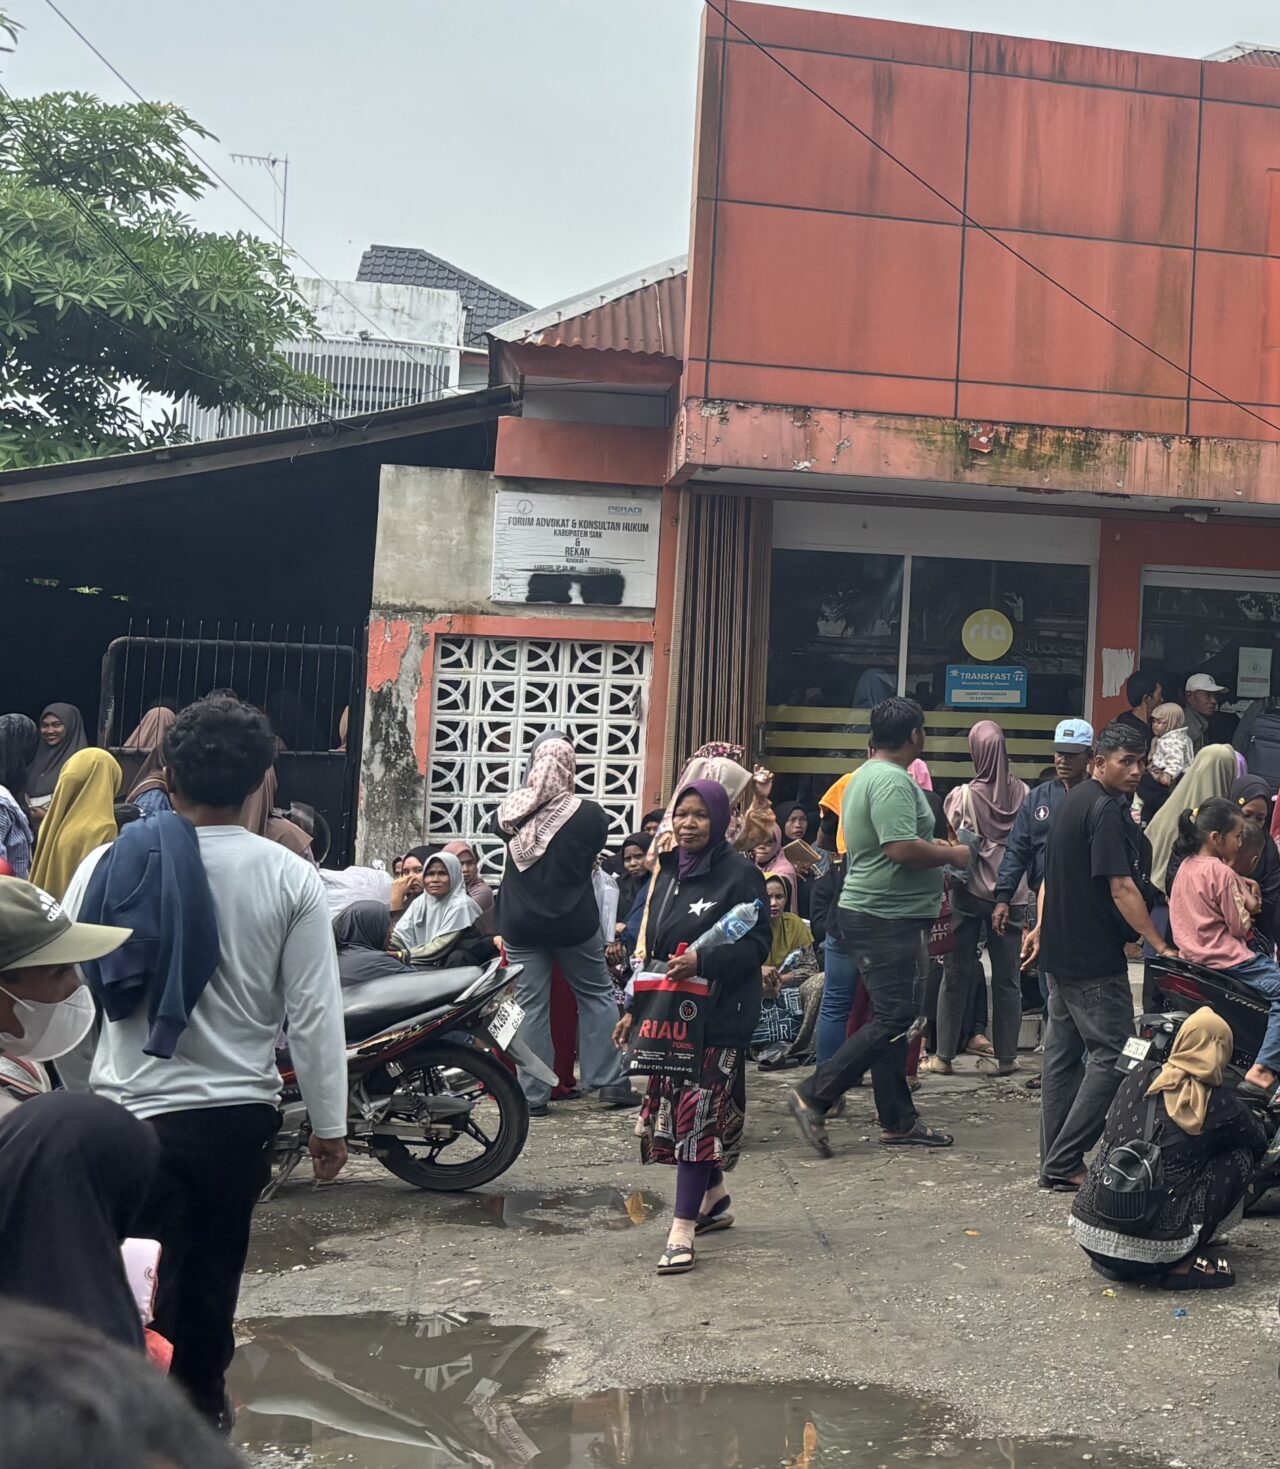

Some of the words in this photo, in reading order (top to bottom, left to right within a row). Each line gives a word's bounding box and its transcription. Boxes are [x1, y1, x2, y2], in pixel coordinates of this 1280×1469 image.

[508, 516, 534, 526] FORUM
[535, 518, 570, 528] ADVOKAT
[572, 519, 577, 528] &
[578, 519, 621, 531] KONSULTAN
[622, 522, 649, 532] HUKUM
[553, 529, 588, 538] KABUPATEN
[589, 530, 602, 538] SIAK
[575, 538, 580, 546] &
[564, 547, 590, 557] REKAN
[969, 616, 1007, 640] ria
[960, 672, 1012, 680] TRANSFAST
[638, 1019, 687, 1040] RIAU
